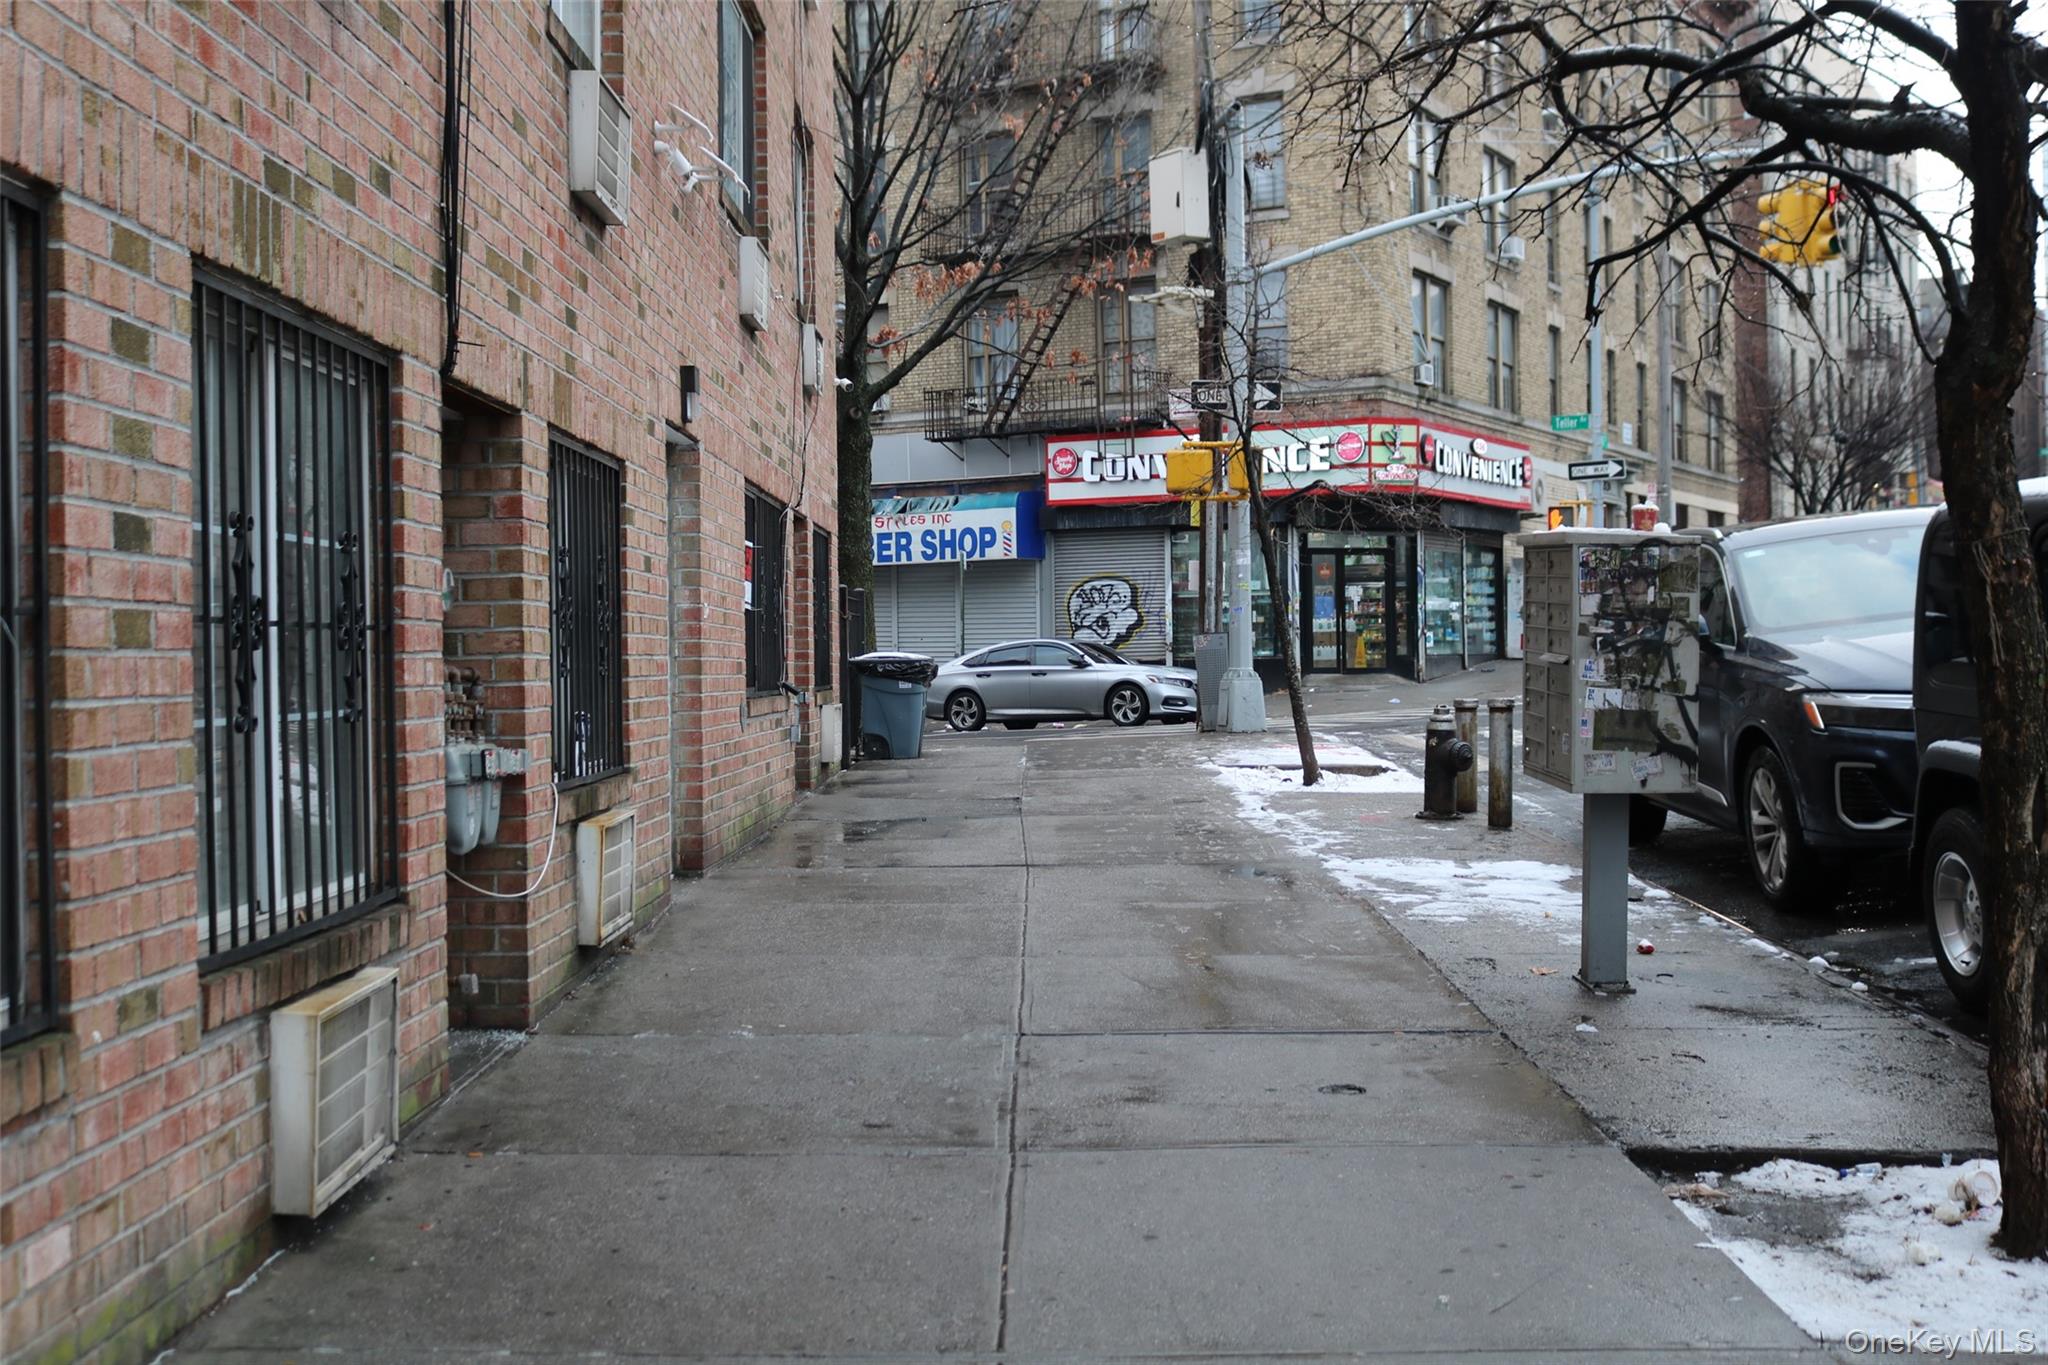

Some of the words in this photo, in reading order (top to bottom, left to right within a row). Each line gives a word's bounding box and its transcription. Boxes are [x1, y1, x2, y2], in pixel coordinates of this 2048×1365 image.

[1200, 389, 1222, 402] ONE
[1556, 417, 1577, 429] Teller
[1435, 439, 1524, 487] CONVENIENCE
[1572, 467, 1587, 476] ONE
[1594, 465, 1608, 473] WAY
[921, 526, 997, 561] SHOP
